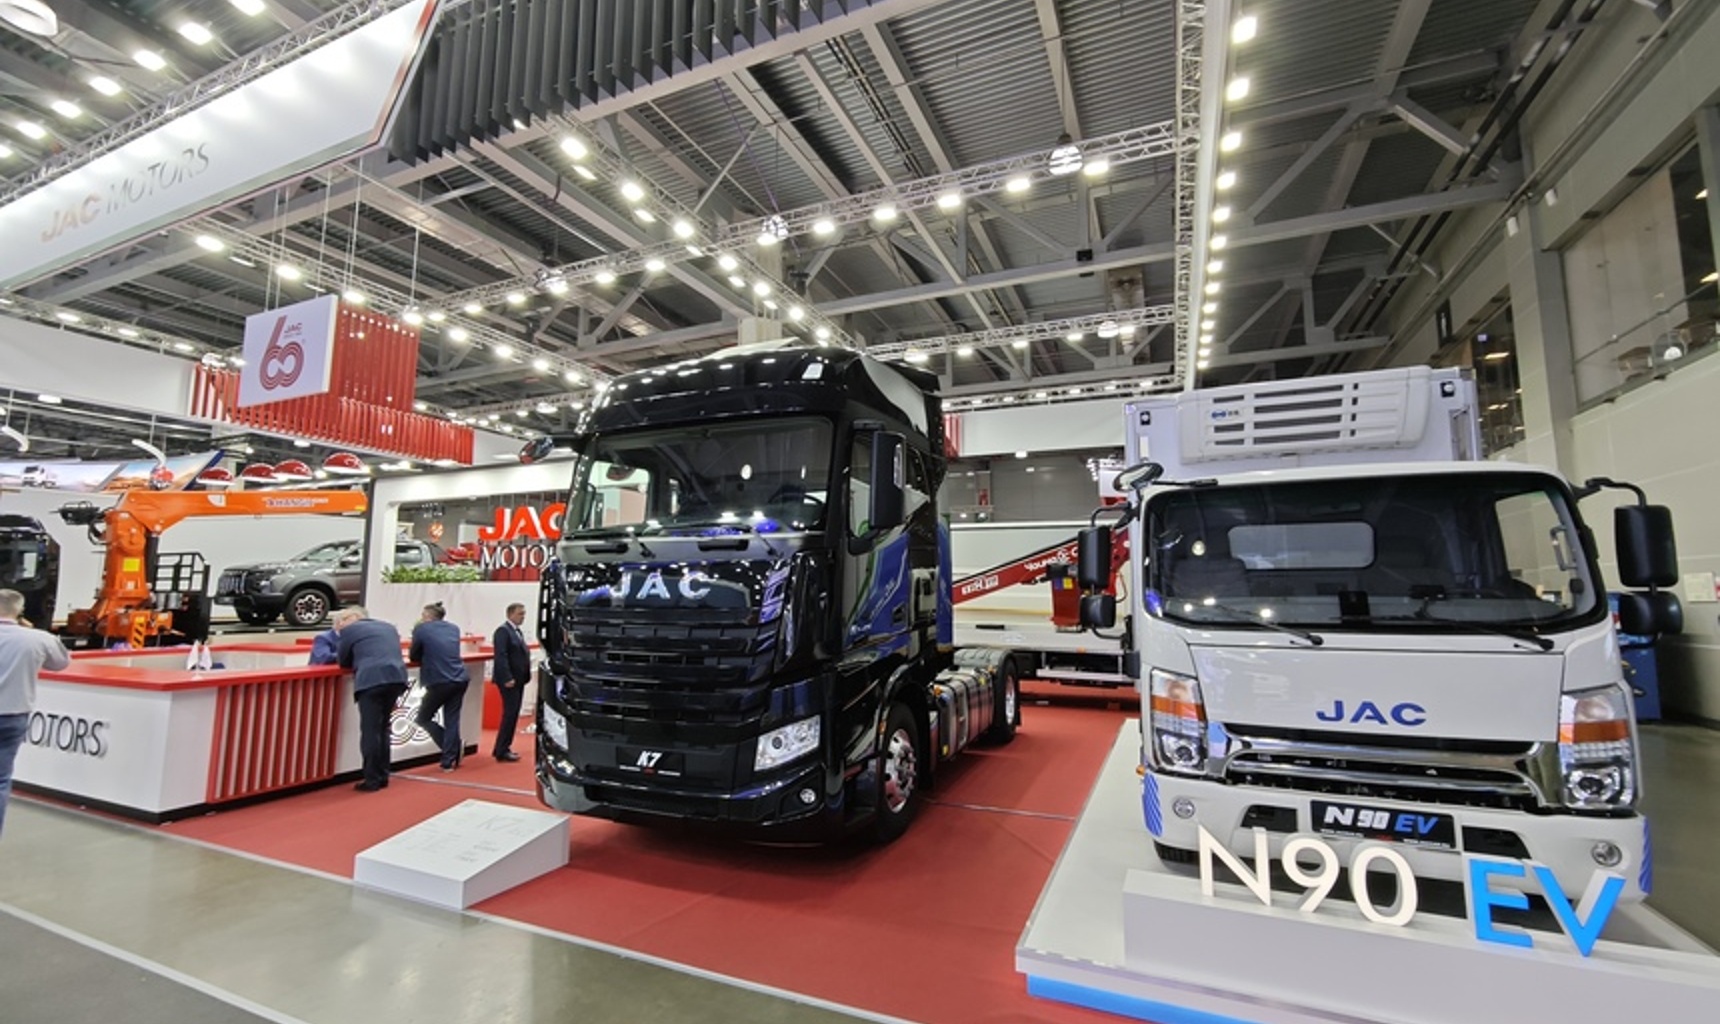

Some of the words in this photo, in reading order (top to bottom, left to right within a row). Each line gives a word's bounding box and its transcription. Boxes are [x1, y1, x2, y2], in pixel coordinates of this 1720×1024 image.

[42, 192, 102, 243] JAC
[106, 143, 209, 214] MOTORS
[478, 502, 566, 541] JAC
[610, 571, 711, 600] JAC
[1316, 699, 1427, 726] JAC
[26, 711, 104, 757] OTORS
[636, 750, 663, 767] K7
[1394, 812, 1439, 834] EV
[1198, 824, 1418, 926] N90
[1465, 856, 1627, 958] EV
